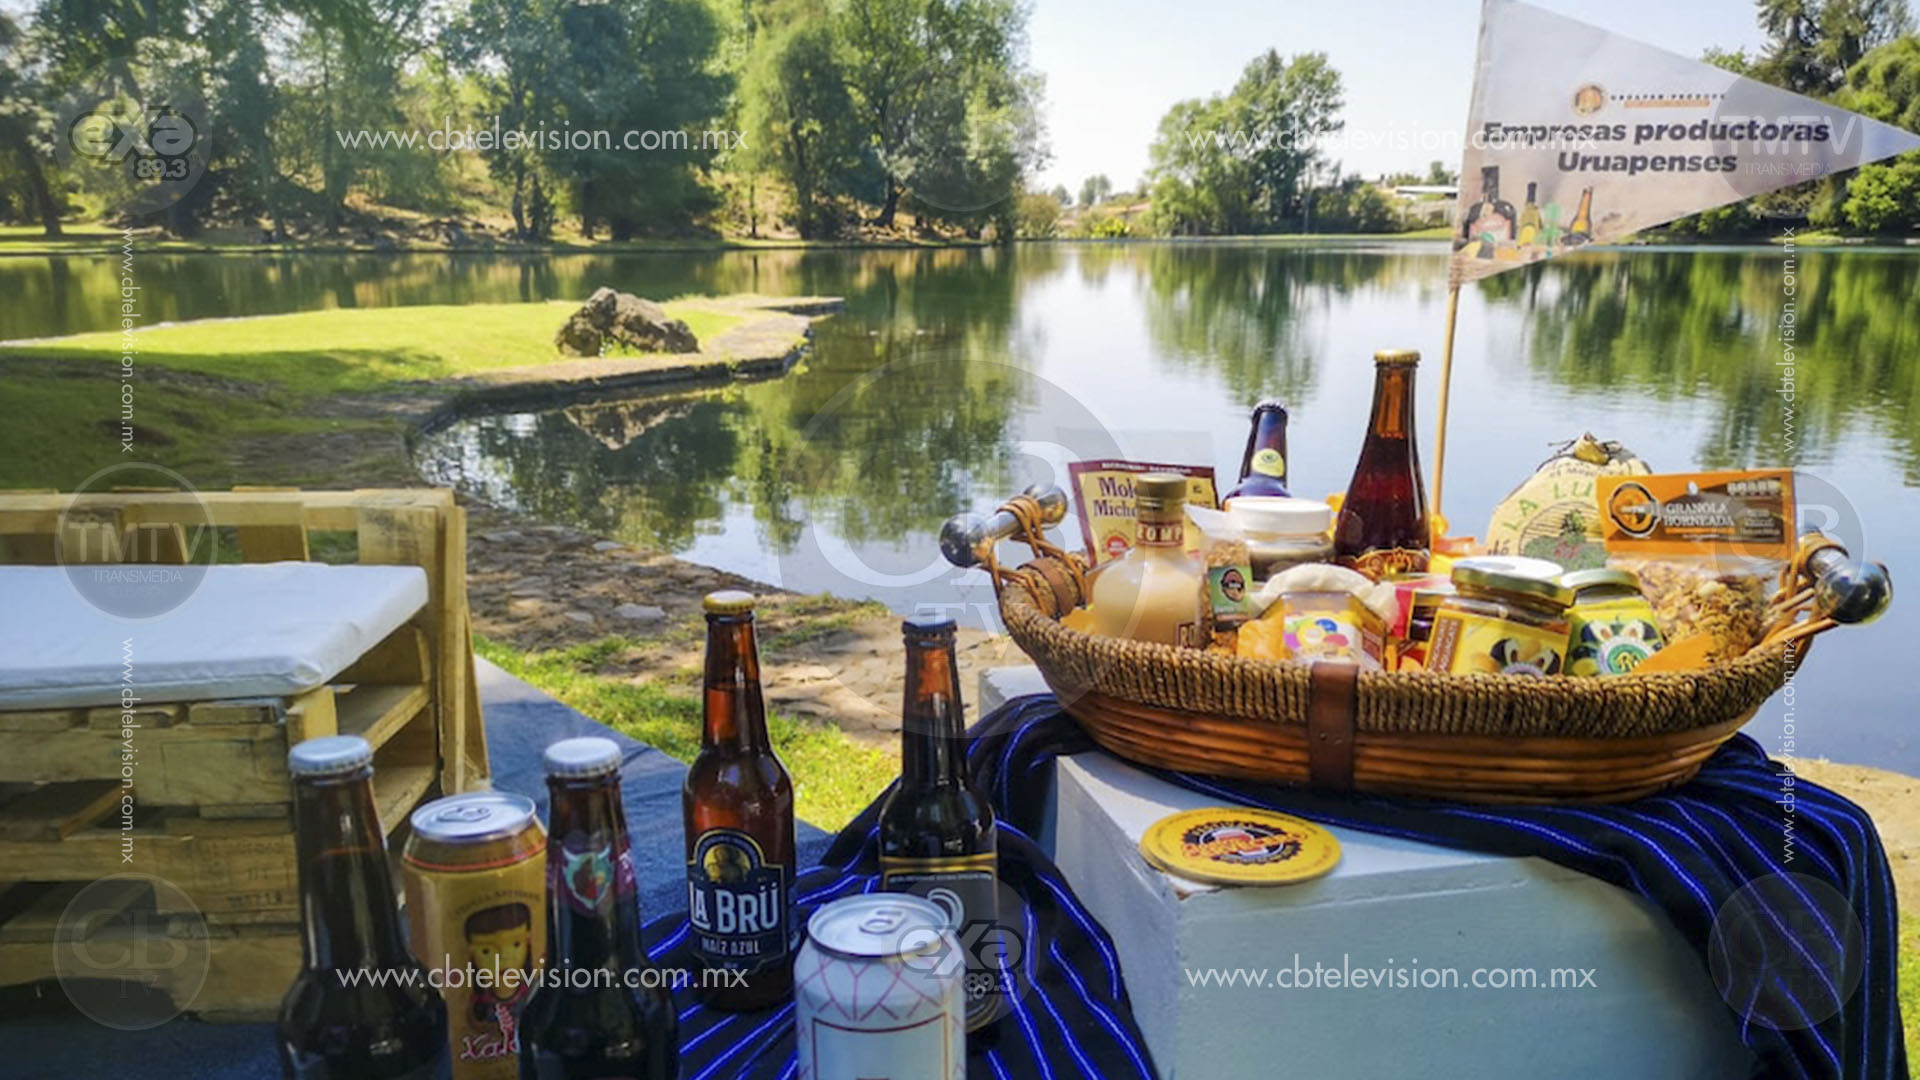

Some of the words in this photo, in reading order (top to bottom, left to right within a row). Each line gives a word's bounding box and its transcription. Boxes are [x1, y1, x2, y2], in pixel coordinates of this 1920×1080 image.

[1483, 121, 1627, 147] Empresas
[1634, 118, 1830, 144] productoras
[1557, 151, 1738, 175] Uruapenses
[1552, 481, 1596, 500] LU
[1665, 502, 1728, 515] GRANOLA
[1663, 515, 1735, 527] HORNEADA
[714, 882, 779, 934] BRÜ
